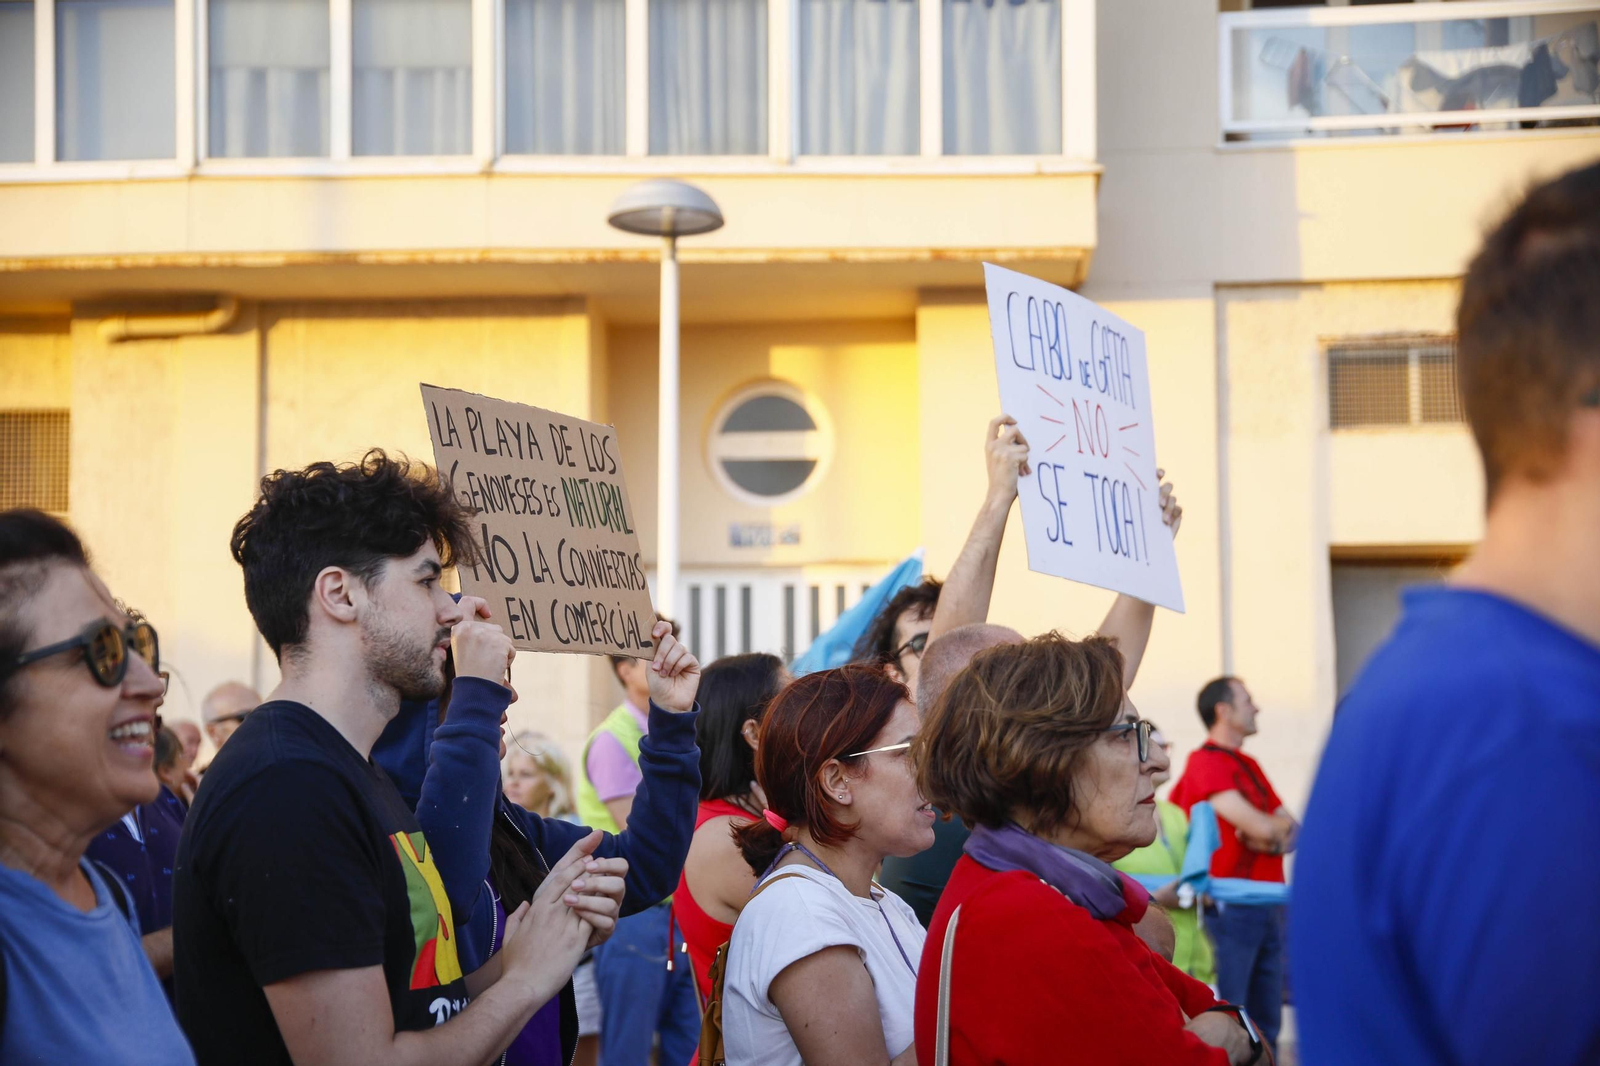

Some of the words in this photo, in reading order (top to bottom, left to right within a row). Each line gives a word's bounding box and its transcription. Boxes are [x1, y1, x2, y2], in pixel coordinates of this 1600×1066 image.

[1006, 291, 1072, 380] CABO
[1090, 319, 1136, 409] GATA
[431, 401, 462, 449] LA
[465, 406, 543, 461] PLAYA
[548, 422, 576, 467] DE
[579, 427, 617, 475] LOS
[1072, 398, 1109, 458] NO
[450, 459, 543, 516] GENOVESES
[542, 483, 561, 517] ES
[560, 476, 633, 535] NATURAL
[1037, 462, 1073, 547] SE
[1084, 471, 1150, 566] TOCA!
[472, 523, 519, 585] NO
[522, 531, 555, 584] LA
[505, 597, 540, 640] EN
